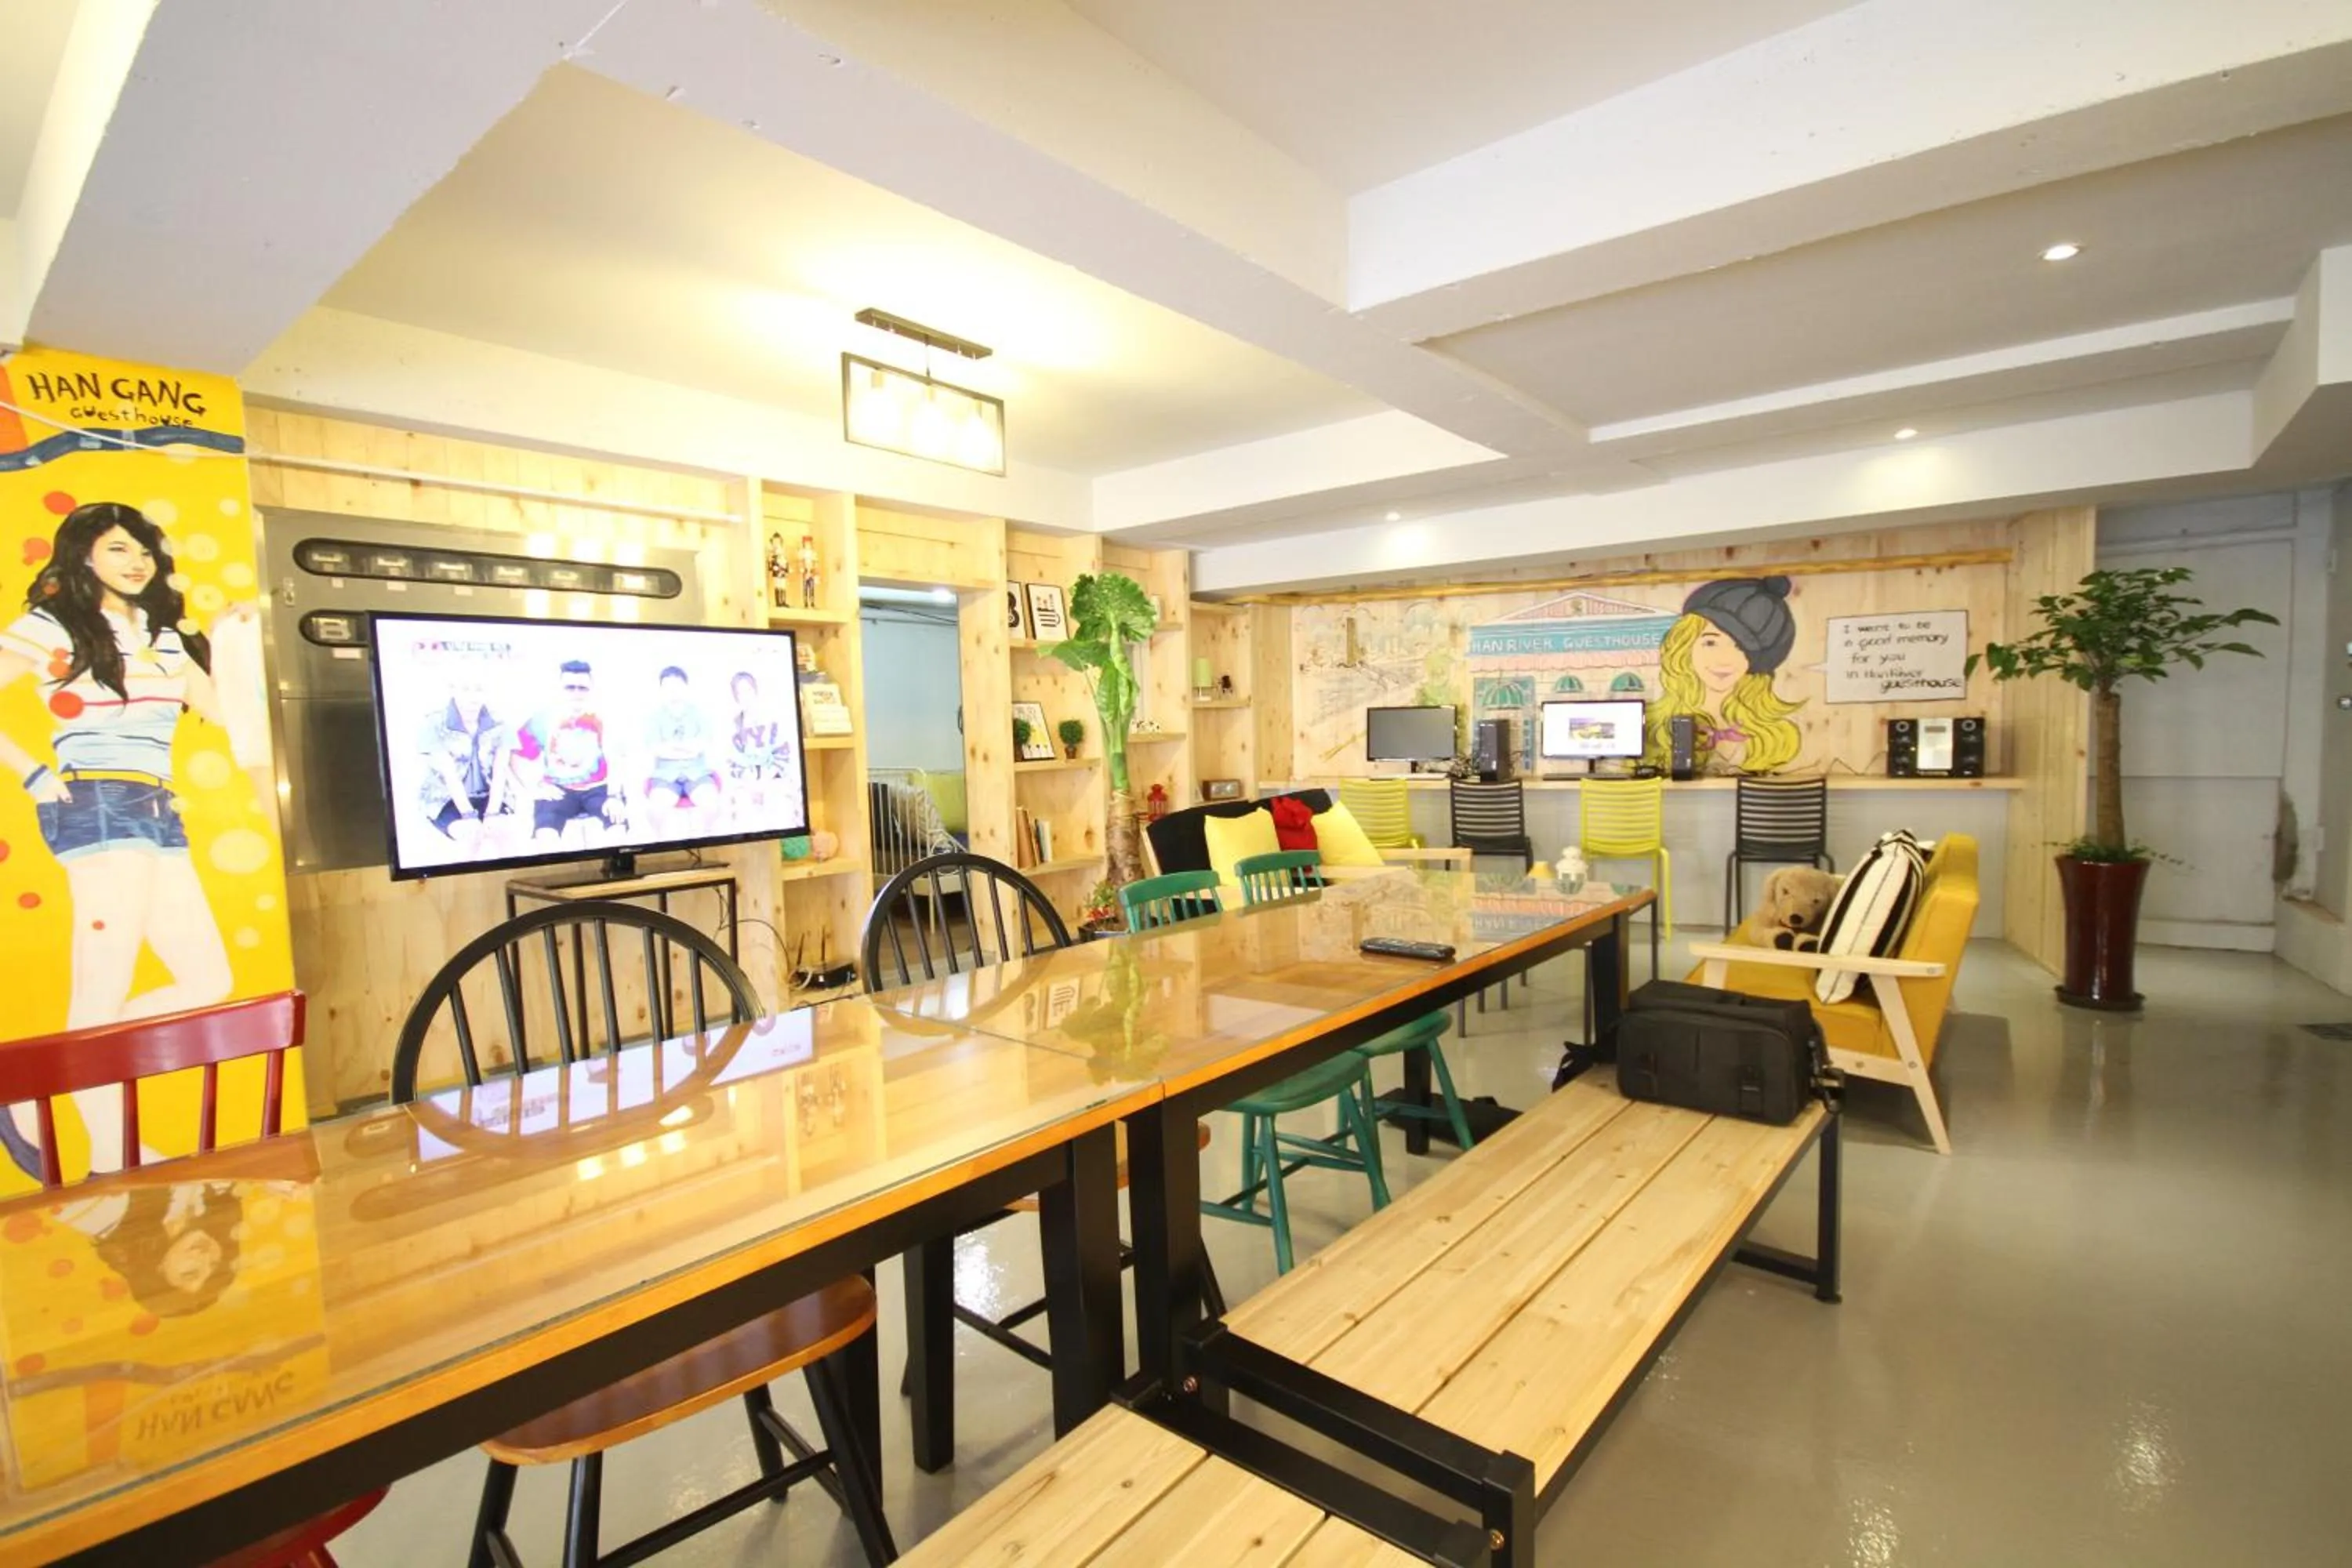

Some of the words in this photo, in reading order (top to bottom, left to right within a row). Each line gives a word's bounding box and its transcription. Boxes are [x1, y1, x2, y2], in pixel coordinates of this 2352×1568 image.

[26, 372, 102, 403] HAN
[111, 378, 206, 417] GANG
[1472, 638, 1503, 652] HAN
[1506, 637, 1554, 652] RIVER
[1562, 633, 1661, 649] GUESTHOUSE
[1858, 635, 1892, 651] good
[1896, 634, 1949, 645] memory
[1852, 653, 1870, 663] for
[1880, 653, 1906, 665] you
[1846, 670, 1859, 679] in
[1880, 678, 1961, 694] guesthouse
